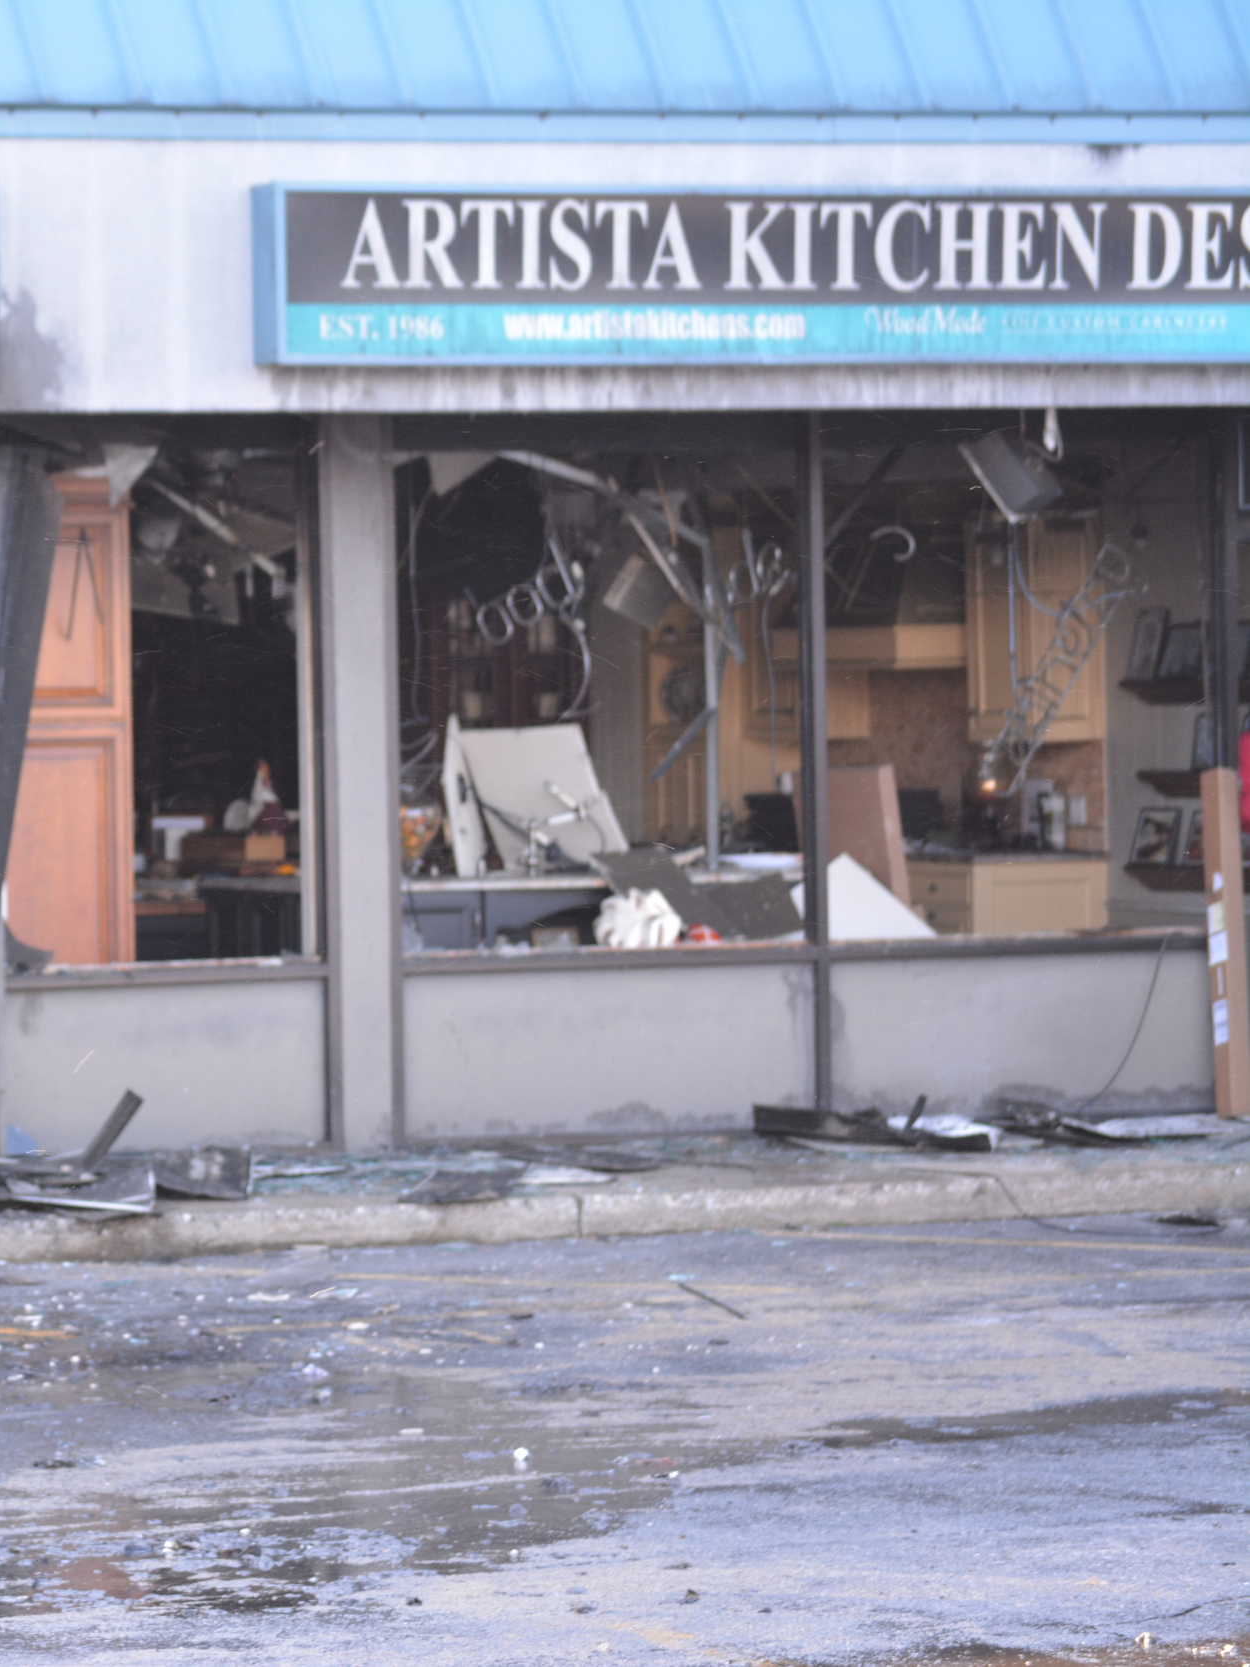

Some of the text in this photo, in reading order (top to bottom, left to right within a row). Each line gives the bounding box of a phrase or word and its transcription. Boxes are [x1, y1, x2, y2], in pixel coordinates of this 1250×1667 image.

[340, 198, 1250, 292] ARTISTA KITCHEN DE
[319, 314, 446, 340] EST. 1986
[503, 308, 806, 341] www.artistakitchens.com
